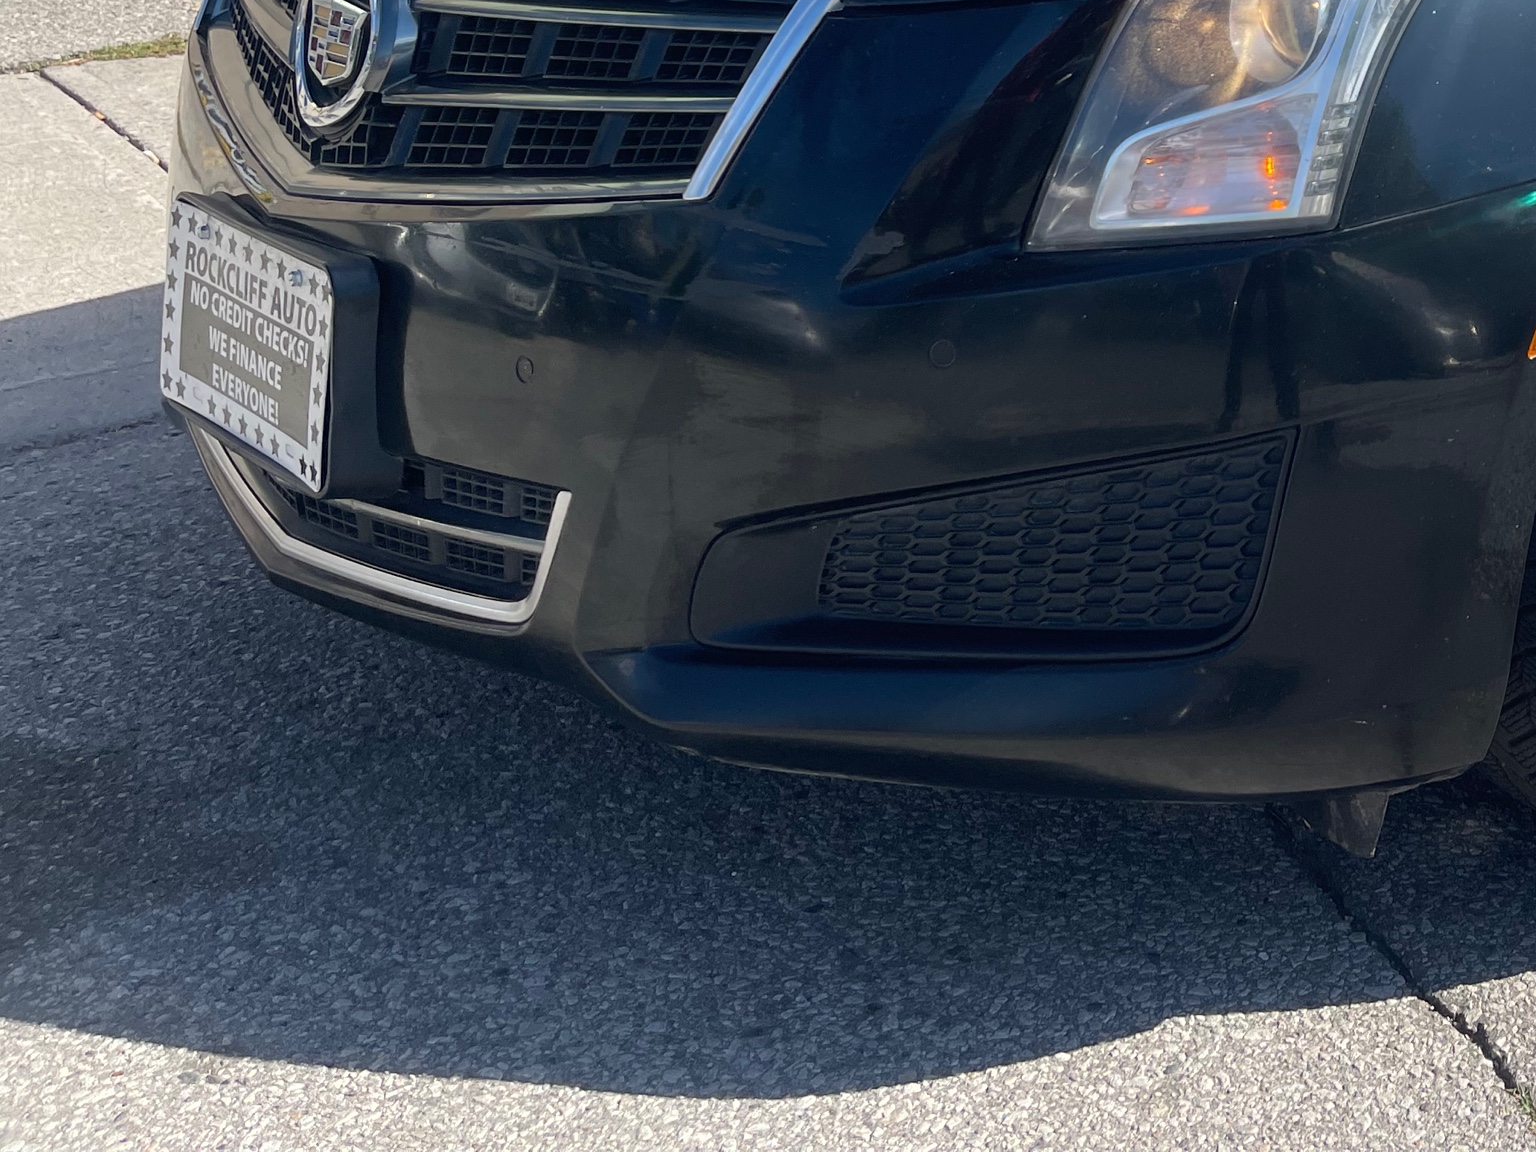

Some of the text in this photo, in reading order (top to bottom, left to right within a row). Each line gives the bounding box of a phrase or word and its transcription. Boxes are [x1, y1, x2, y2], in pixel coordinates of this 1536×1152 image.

[185, 240, 317, 337] ROCKCLIFF AUTO
[190, 279, 310, 368] NO CREDIT CHECKS!
[208, 325, 283, 391] WE FINANCE
[211, 363, 280, 426] EVERYONE!
